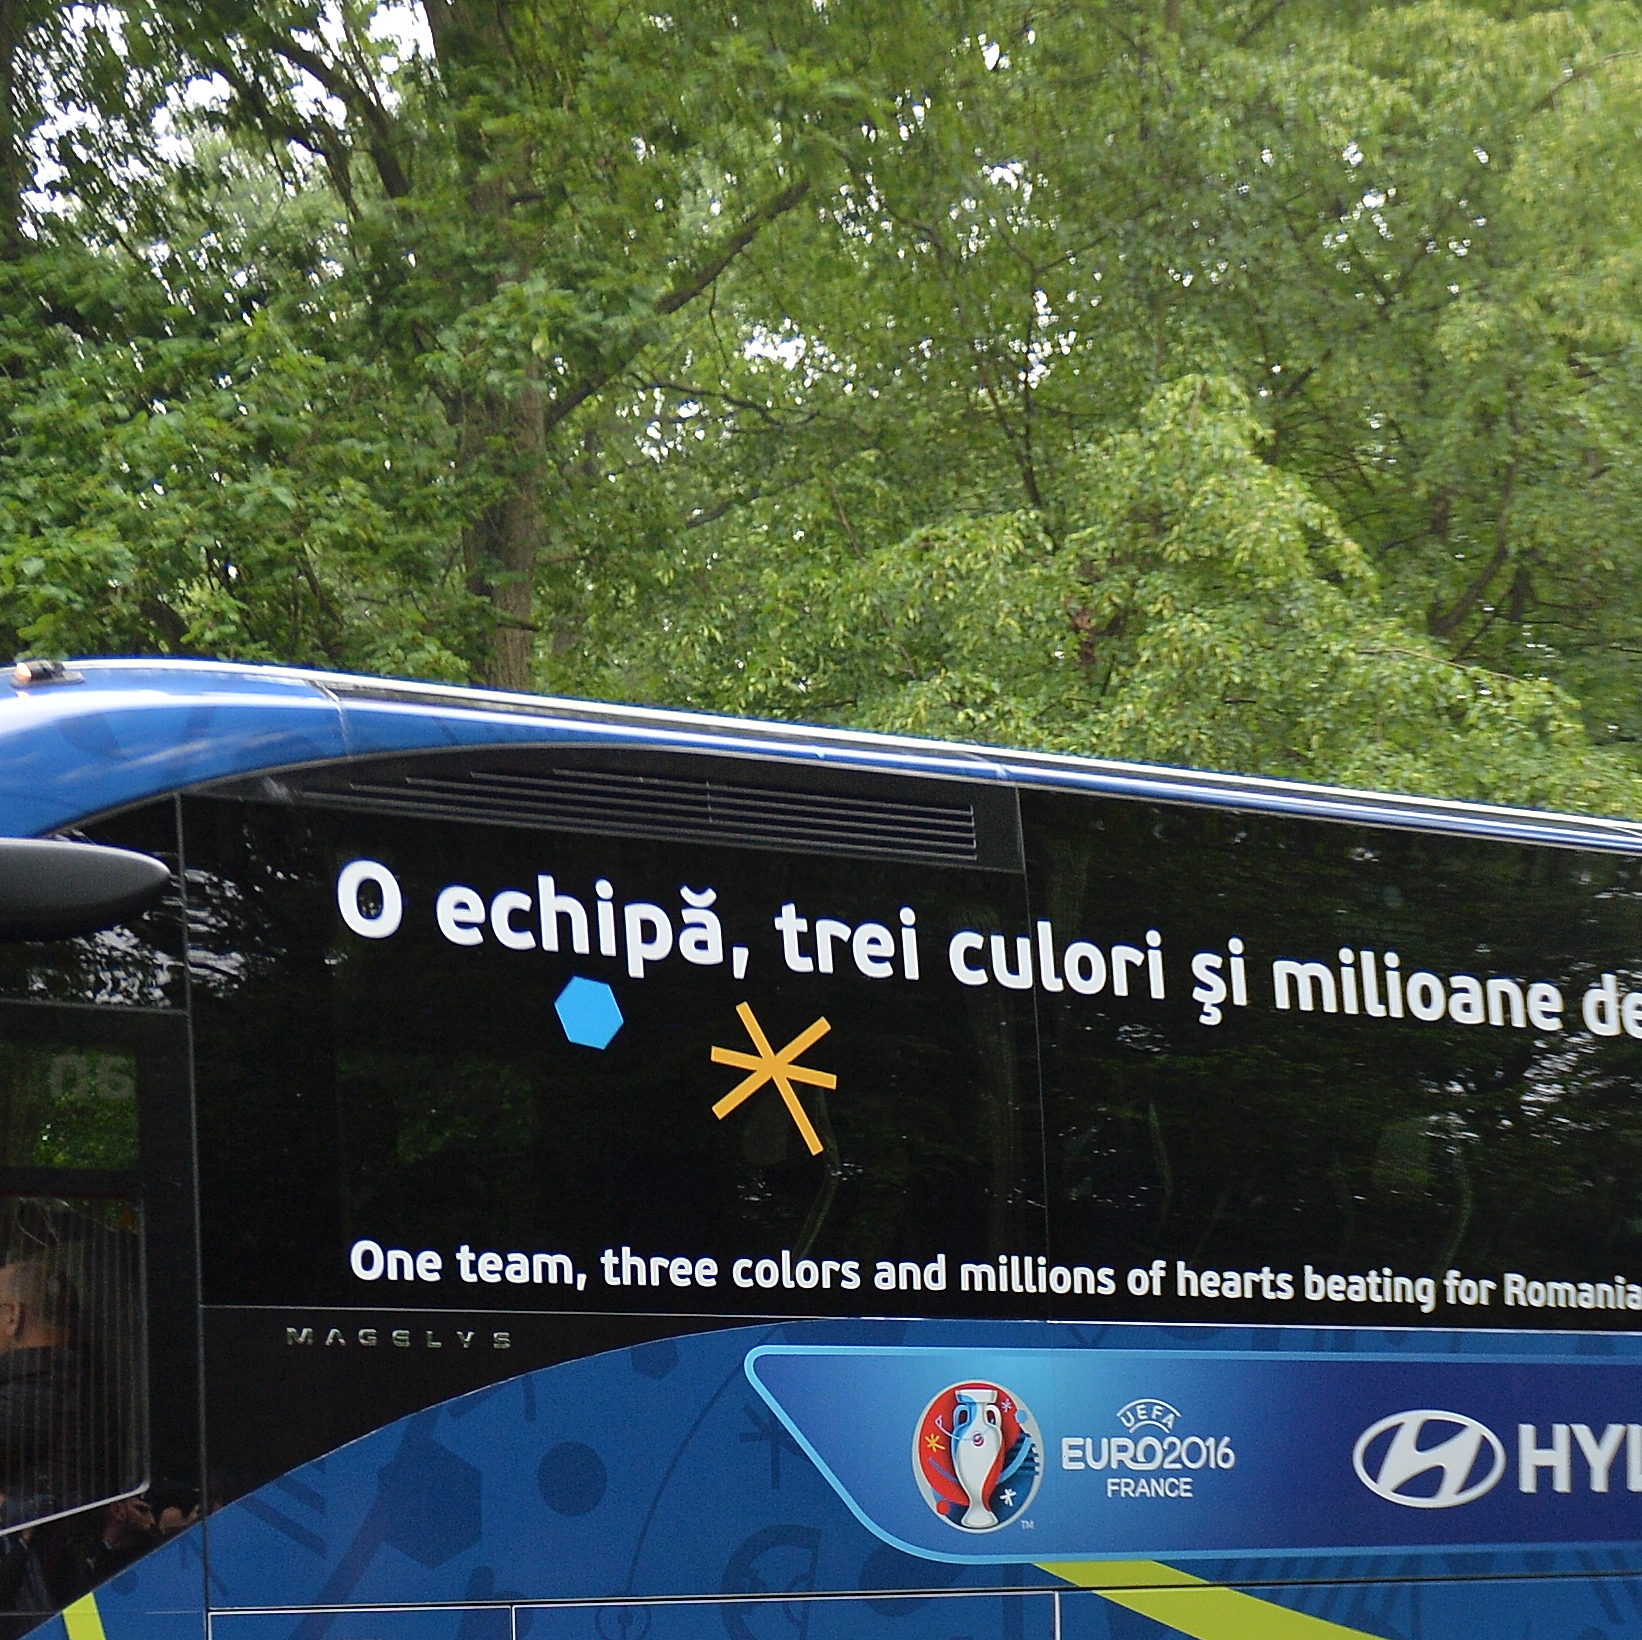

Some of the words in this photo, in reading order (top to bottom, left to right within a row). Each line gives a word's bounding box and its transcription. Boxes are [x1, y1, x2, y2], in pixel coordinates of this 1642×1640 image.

[337, 859, 403, 940] O
[436, 874, 749, 980] echipă,
[774, 902, 920, 981] trei
[948, 917, 1166, 1000] culori
[1272, 946, 1564, 1033] milioane
[349, 1238, 443, 1282] One
[455, 1243, 588, 1292] team,
[599, 1246, 719, 1288] three
[732, 1248, 861, 1290] colors
[873, 1252, 947, 1291] and
[960, 1253, 1116, 1295] millions
[1126, 1259, 1167, 1296] of
[1176, 1260, 1294, 1300] hearts
[1303, 1264, 1437, 1313] beating
[1442, 1268, 1498, 1307] for
[285, 1326, 512, 1350] MAGELYS
[1120, 1403, 1176, 1430] UEFA
[1061, 1435, 1237, 1471] EURO2016
[1106, 1476, 1194, 1498] FRANCE
